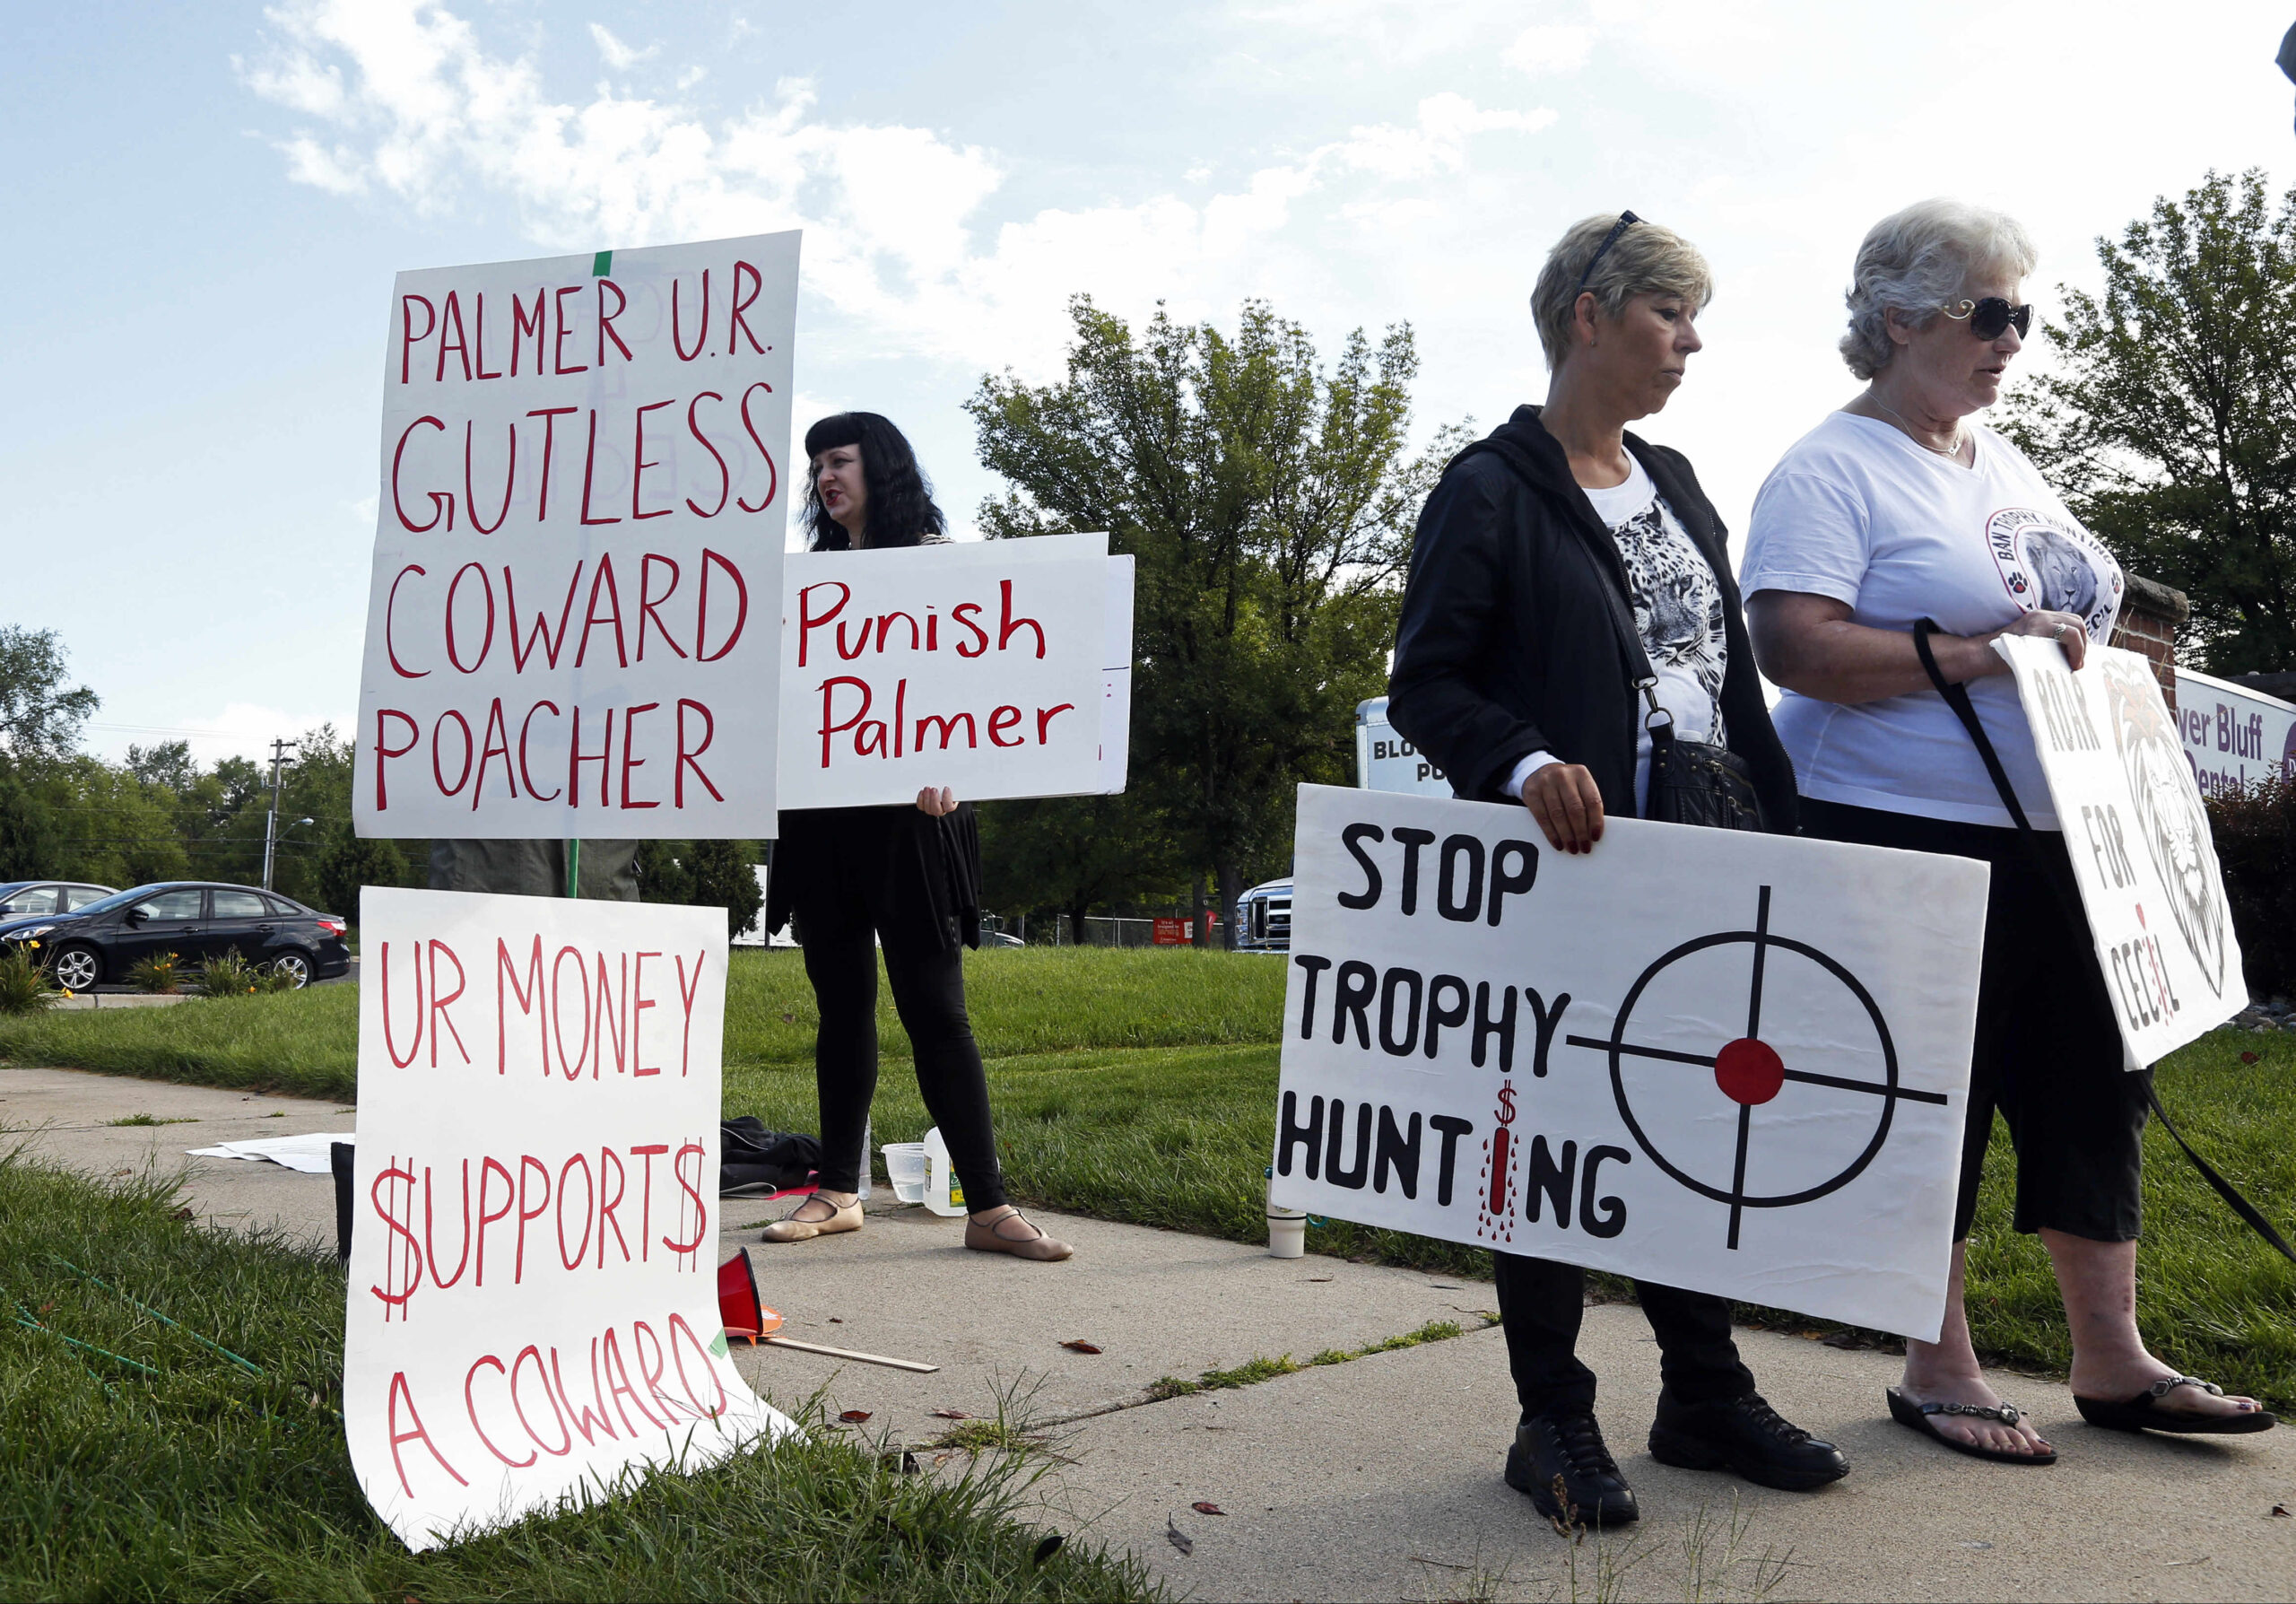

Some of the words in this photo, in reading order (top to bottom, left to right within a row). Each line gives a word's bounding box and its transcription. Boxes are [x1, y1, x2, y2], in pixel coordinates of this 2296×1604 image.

[403, 280, 631, 384] PALMER
[393, 382, 776, 535] GUTLESS
[1991, 531, 2015, 562] BAN
[1993, 510, 2040, 531] TROPHY
[387, 548, 748, 678] COWARD
[797, 580, 1046, 667] Punish
[374, 697, 724, 811] POACHER
[815, 676, 1075, 769] Palmer
[2033, 668, 2101, 752] ROAR
[2215, 702, 2263, 761] Bluff
[1336, 822, 1540, 928] STOP
[2081, 804, 2137, 890] FOR
[381, 938, 471, 1069] UR
[498, 933, 706, 1082] MONEY
[1294, 955, 1572, 1078] TROPHY
[2110, 932, 2180, 1032] CECIL
[1277, 1090, 1632, 1240] HUNTING
[370, 1136, 707, 1323] $UPPORT$
[388, 1370, 471, 1500] A
[465, 1312, 727, 1469] COWARD
